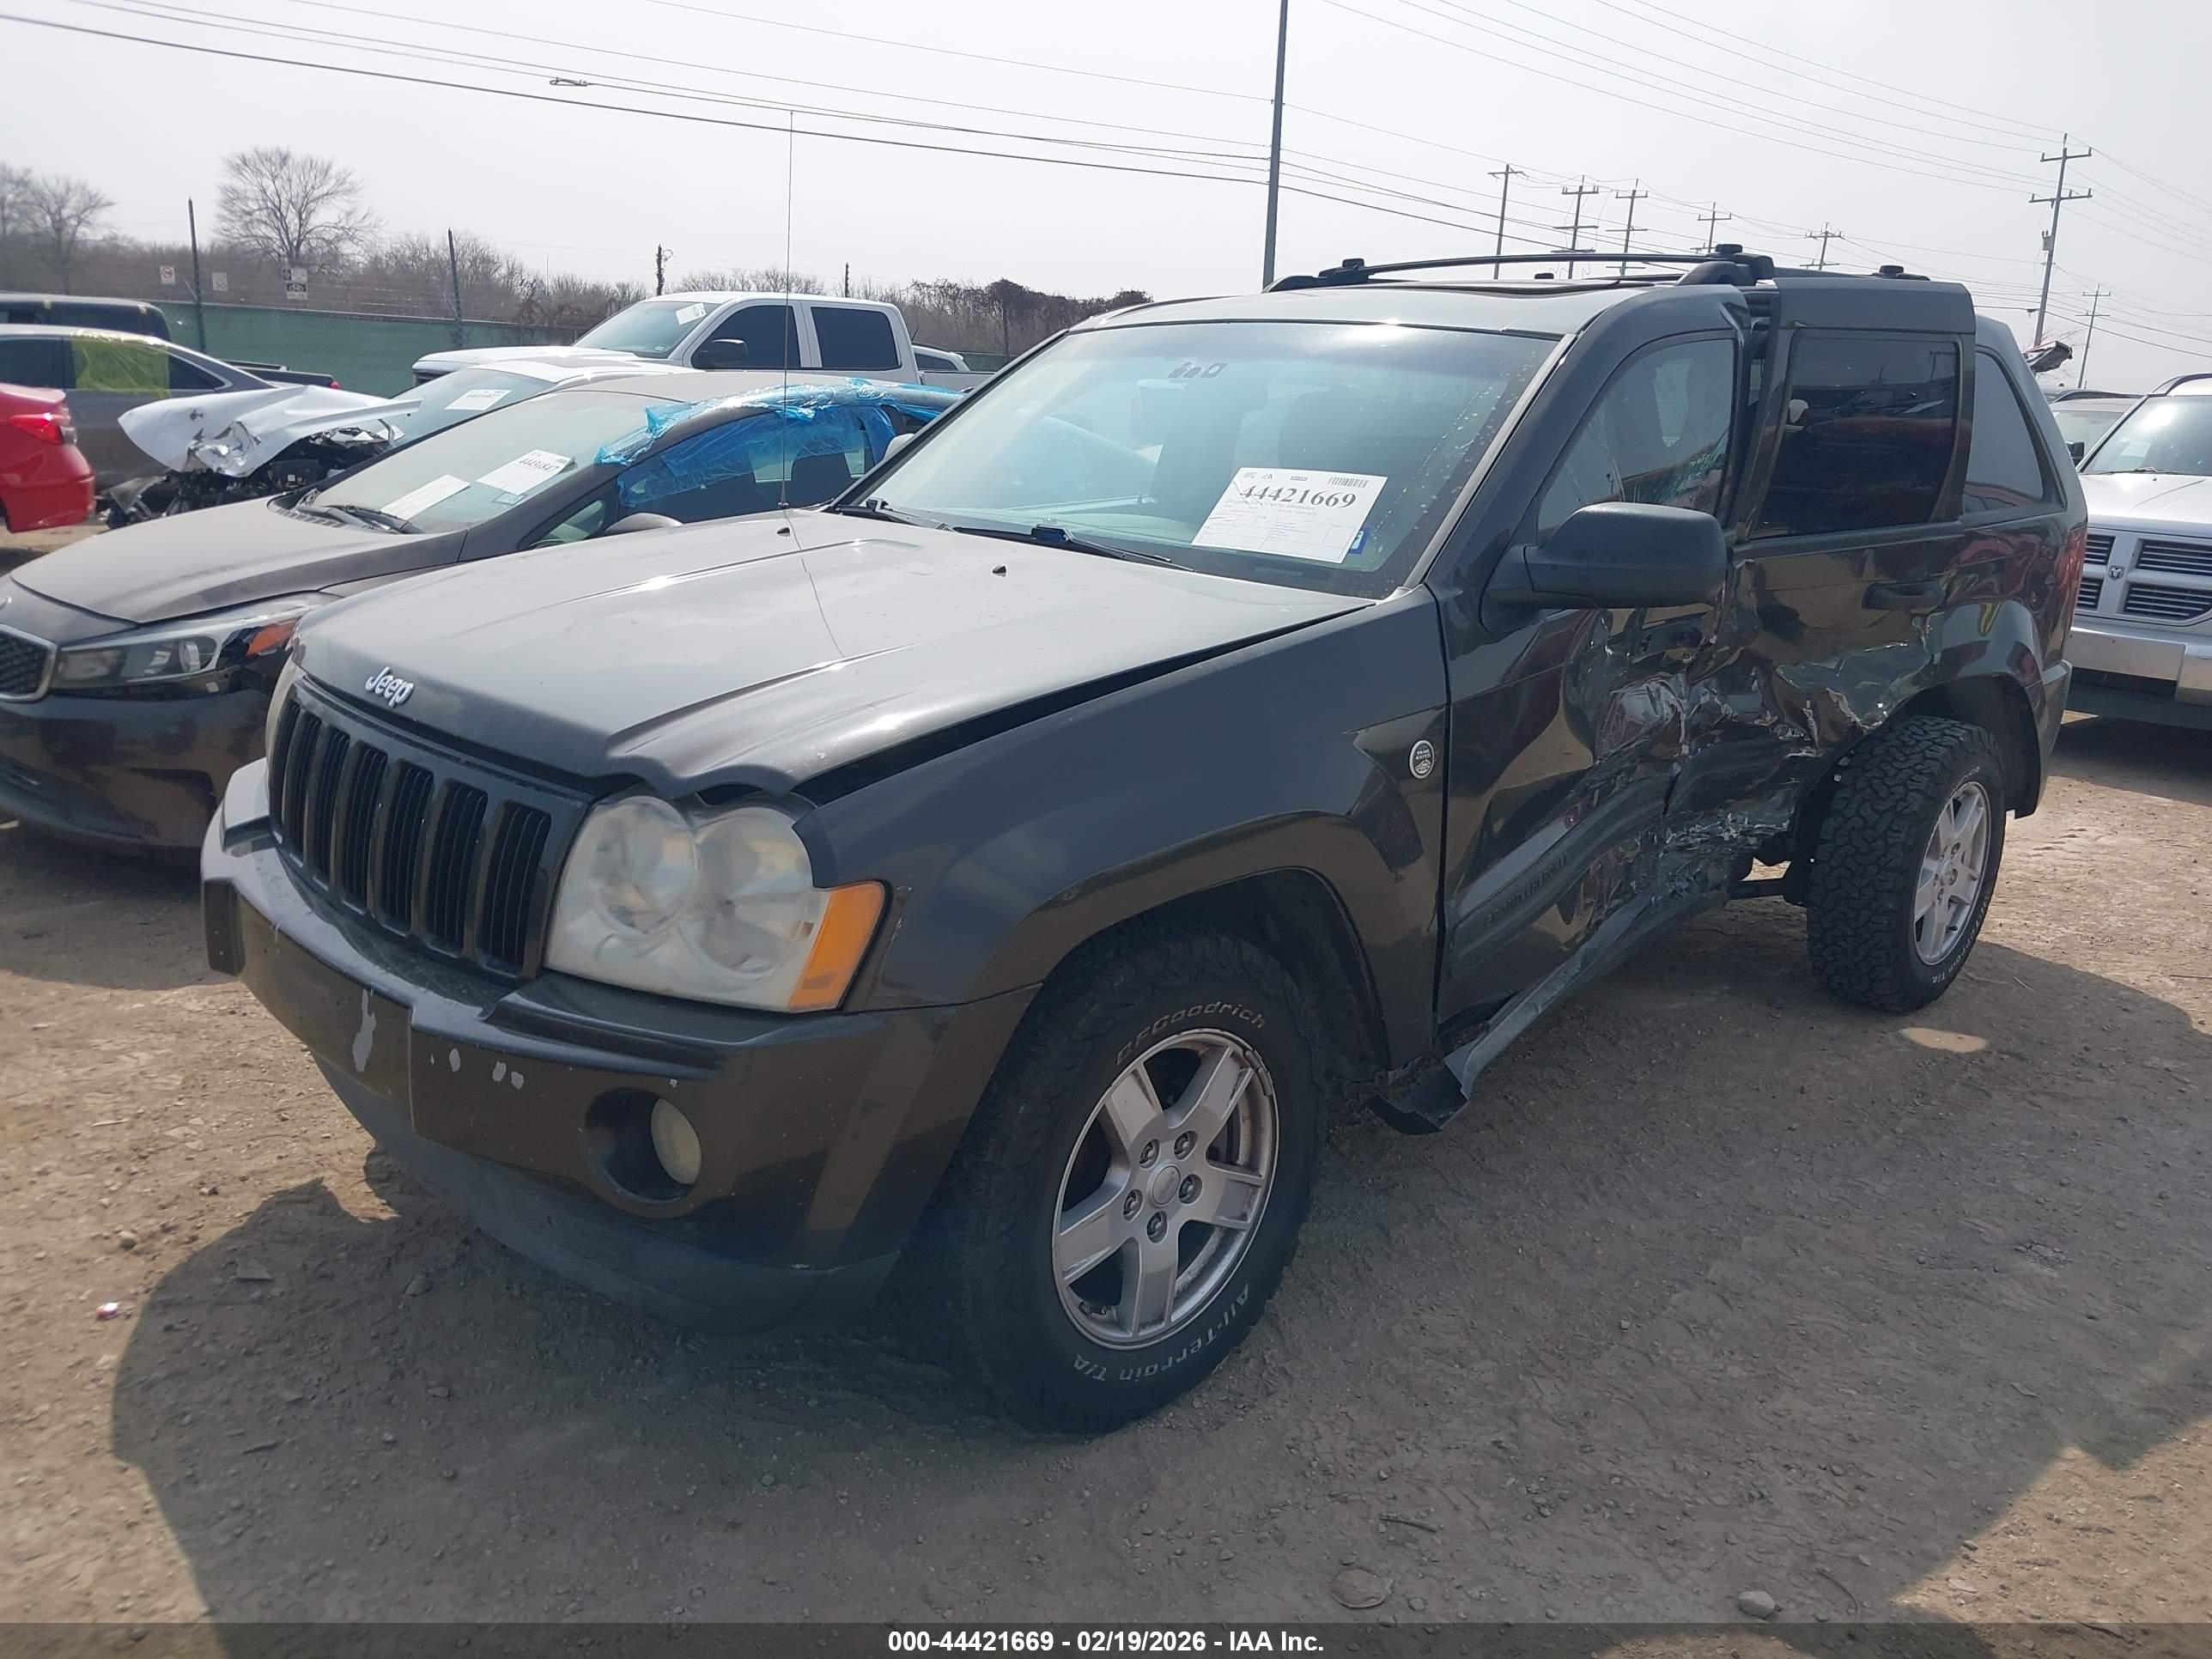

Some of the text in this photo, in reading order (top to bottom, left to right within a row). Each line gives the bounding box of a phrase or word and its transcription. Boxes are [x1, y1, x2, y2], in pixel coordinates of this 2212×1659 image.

[1239, 484, 1357, 508] 44421669
[365, 666, 414, 708] Jeep
[1119, 1284, 1249, 1382] All-Terrain
